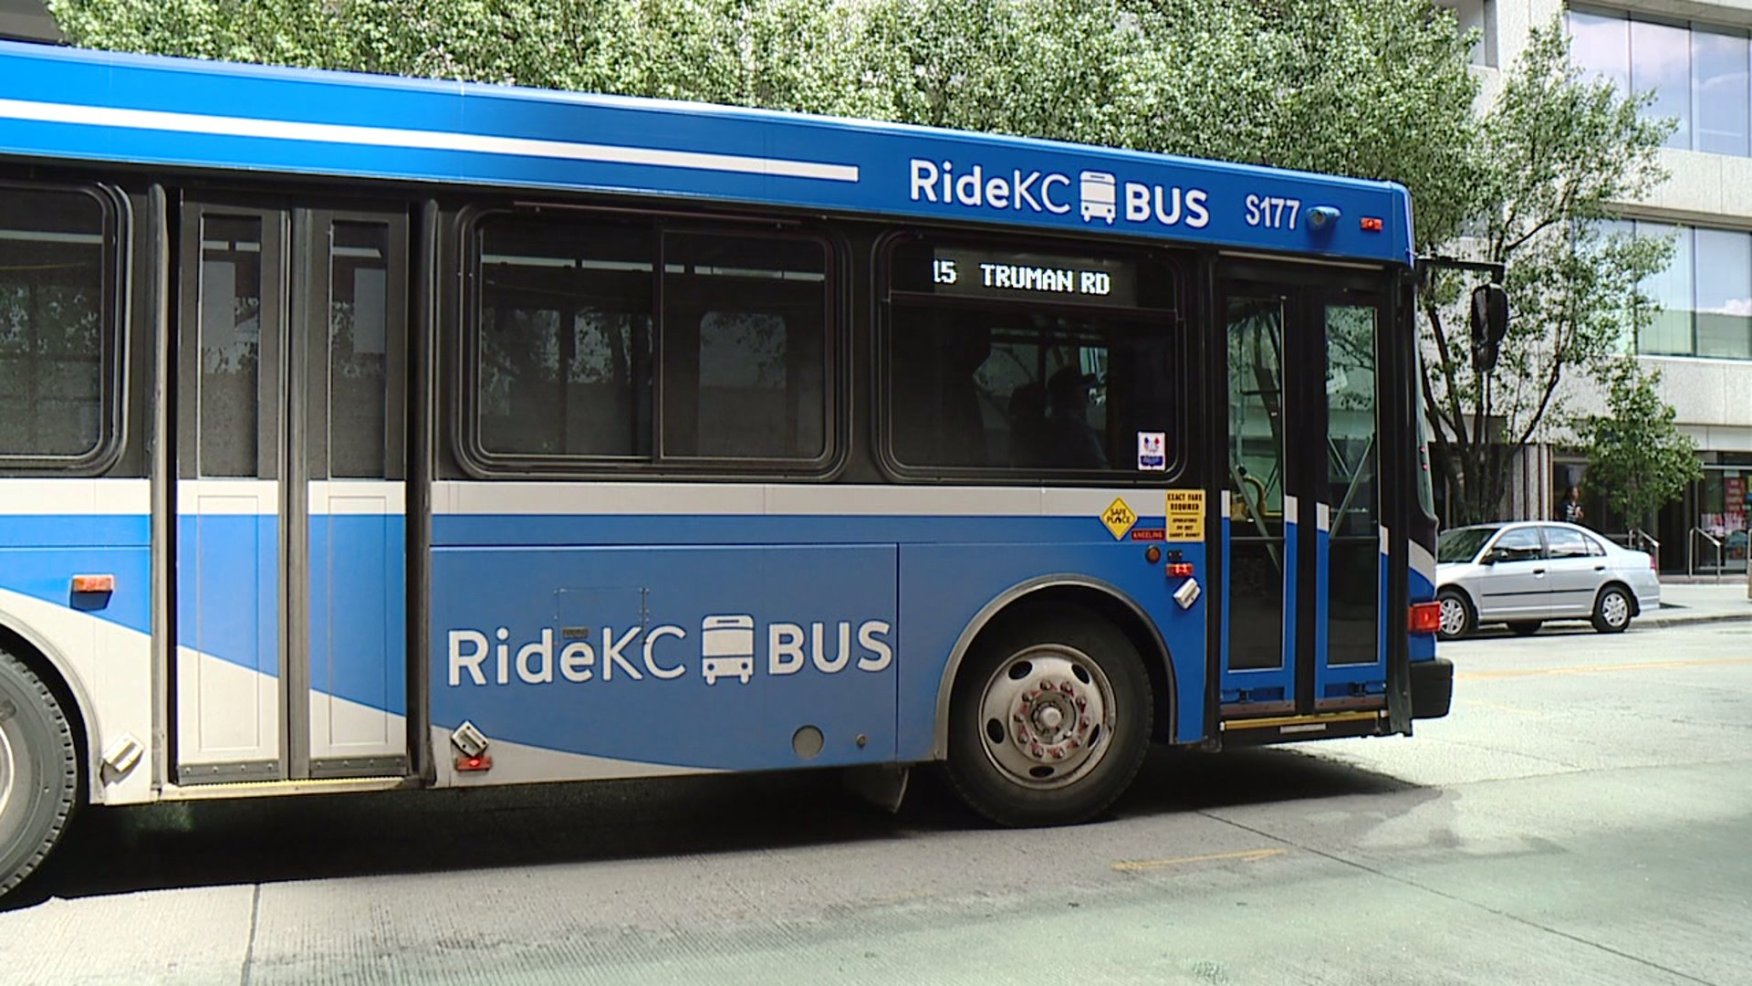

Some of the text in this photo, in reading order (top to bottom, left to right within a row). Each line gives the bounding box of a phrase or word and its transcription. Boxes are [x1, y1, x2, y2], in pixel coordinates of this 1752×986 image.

[910, 159, 1210, 228] RideKC BUS
[1245, 193, 1301, 231] S177
[980, 263, 1074, 293] TRUMAN
[1081, 271, 1111, 296] RD
[447, 619, 894, 687] RideKC BUS
